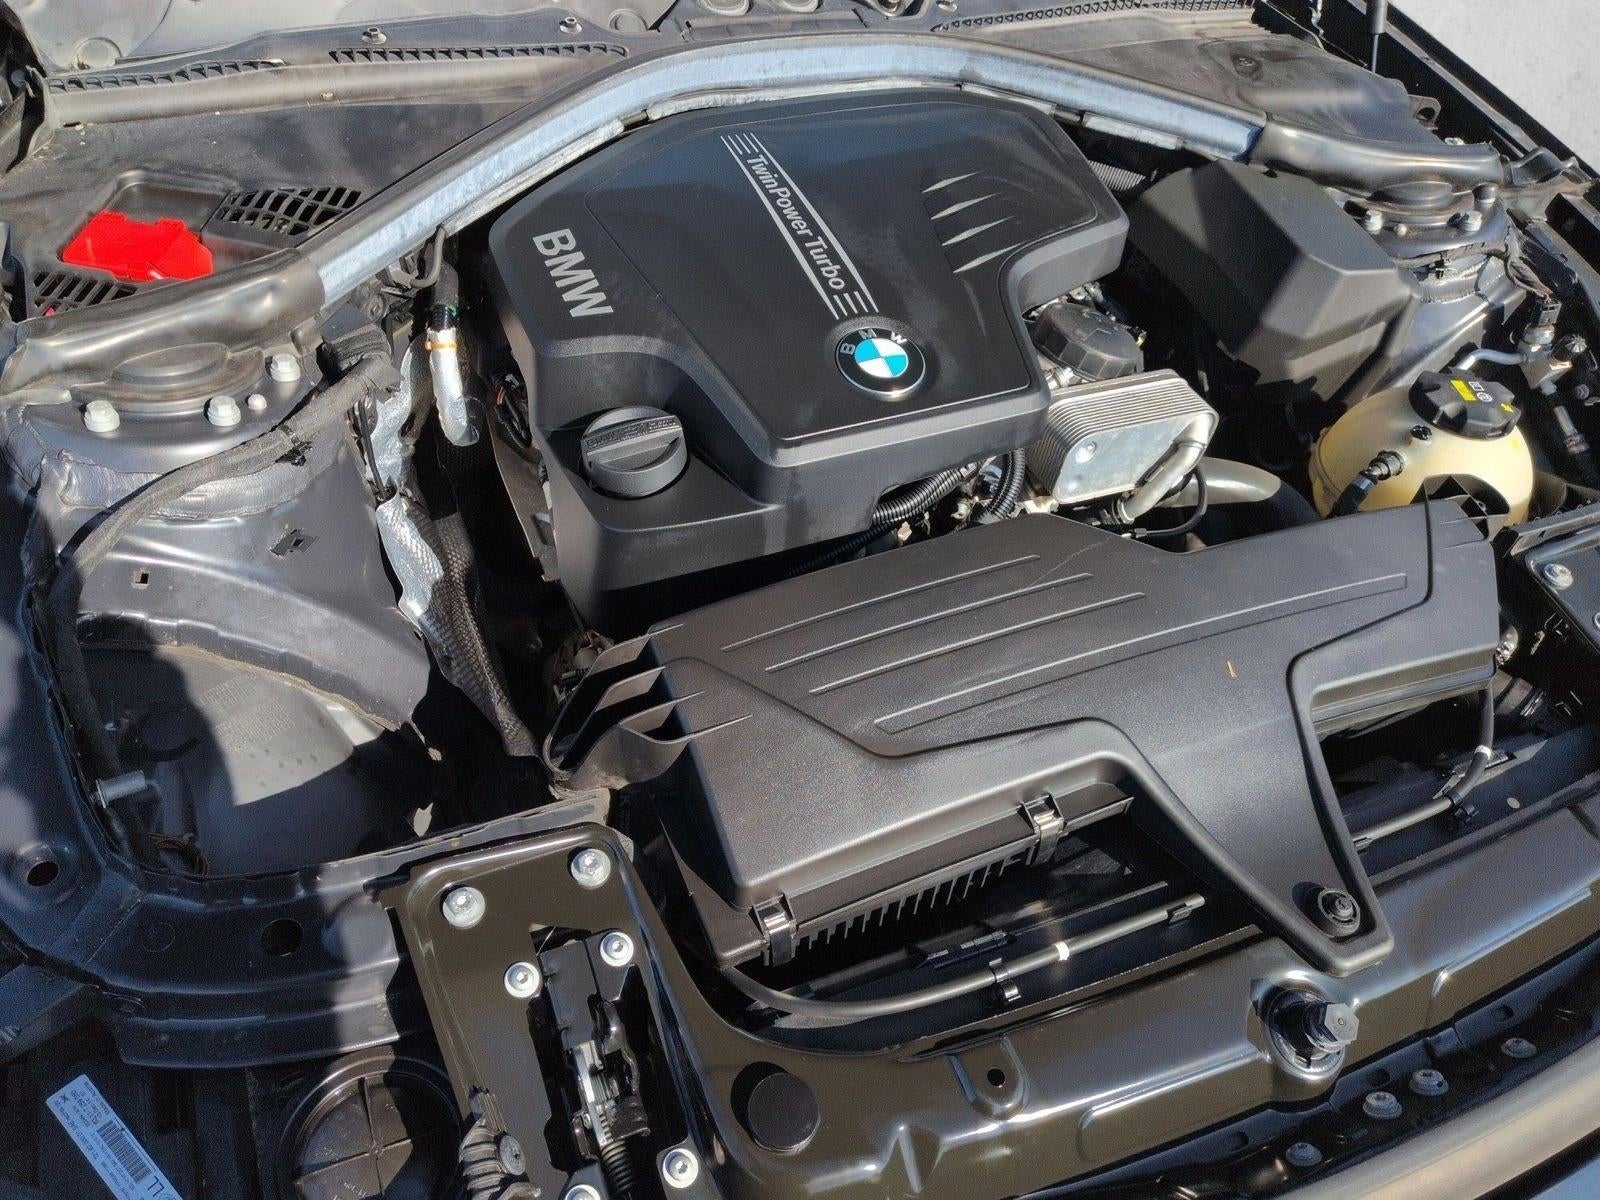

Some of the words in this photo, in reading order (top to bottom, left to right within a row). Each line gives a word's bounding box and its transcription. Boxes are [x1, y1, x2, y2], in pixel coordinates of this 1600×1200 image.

[746, 154, 814, 237] TwinPower
[804, 236, 847, 290] Turbo
[532, 227, 614, 318] BMW
[839, 328, 908, 355] BMW
